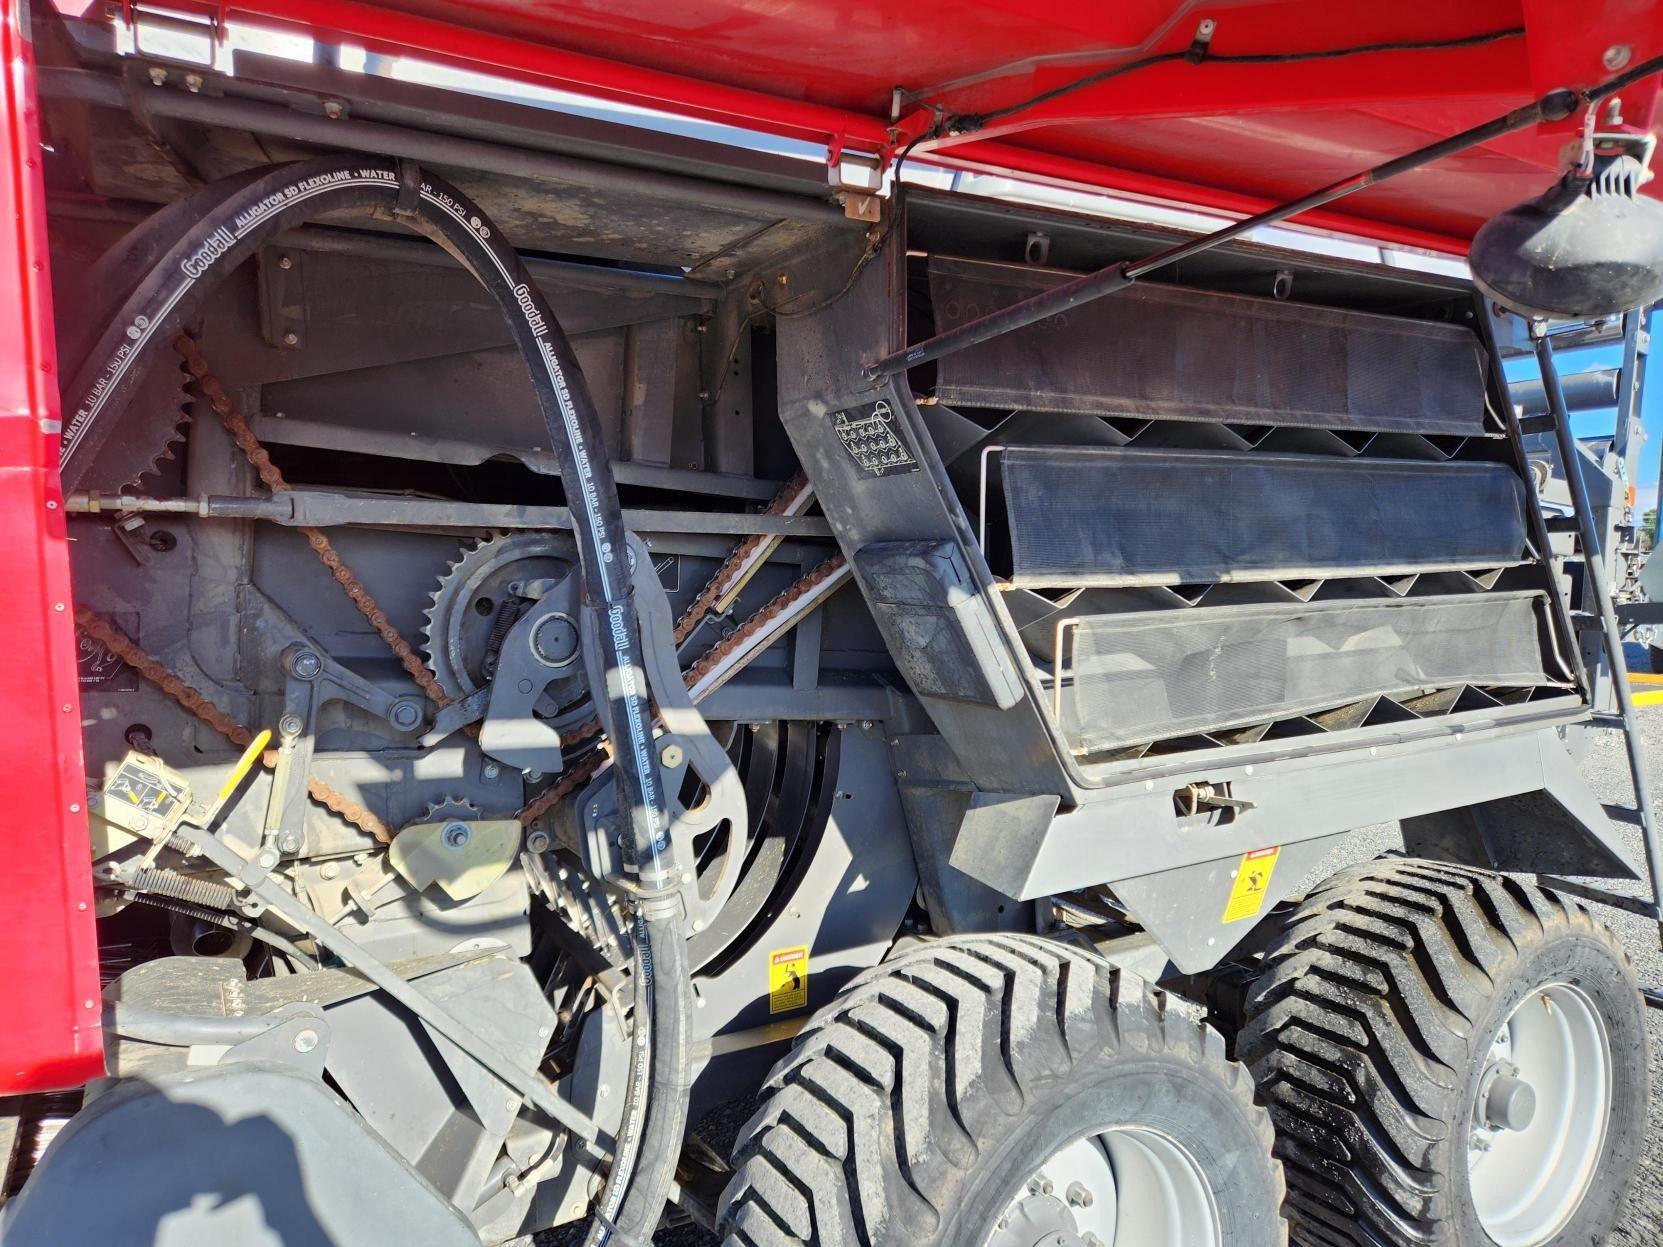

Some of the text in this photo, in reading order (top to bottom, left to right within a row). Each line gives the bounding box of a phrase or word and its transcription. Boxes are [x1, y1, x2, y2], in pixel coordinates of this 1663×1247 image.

[180, 225, 237, 279] Goodall
[235, 192, 286, 229] ALLIGATOR
[284, 185, 299, 198] SD
[299, 170, 351, 192] FLEXOLINE
[359, 169, 396, 181] WATER
[420, 182, 432, 193] AR
[438, 192, 454, 206] 150
[453, 203, 467, 217] PSI
[513, 283, 549, 337] Goodall
[544, 342, 567, 389] ALLIGATOR
[63, 409, 89, 440] WATER
[85, 395, 97, 407] 10
[93, 377, 109, 397] BAR
[107, 358, 122, 375] 150
[118, 344, 132, 359] PSI
[561, 388, 571, 401] SD
[564, 398, 584, 444] FLEXOLINE
[578, 449, 593, 479] WATER
[586, 482, 595, 493] 10
[590, 492, 600, 509] BAR
[594, 513, 604, 527] 150
[597, 526, 606, 539] PSI
[608, 605, 630, 651] Goodall
[622, 655, 638, 696] ALLIGATOR
[629, 695, 638, 707] SD
[630, 705, 646, 748] FLEXOLINE
[639, 748, 651, 775] WATER
[645, 777, 653, 786] 10
[646, 786, 656, 801] BAR
[626, 1109, 638, 1136] WATER
[633, 1080, 642, 1097] BAR
